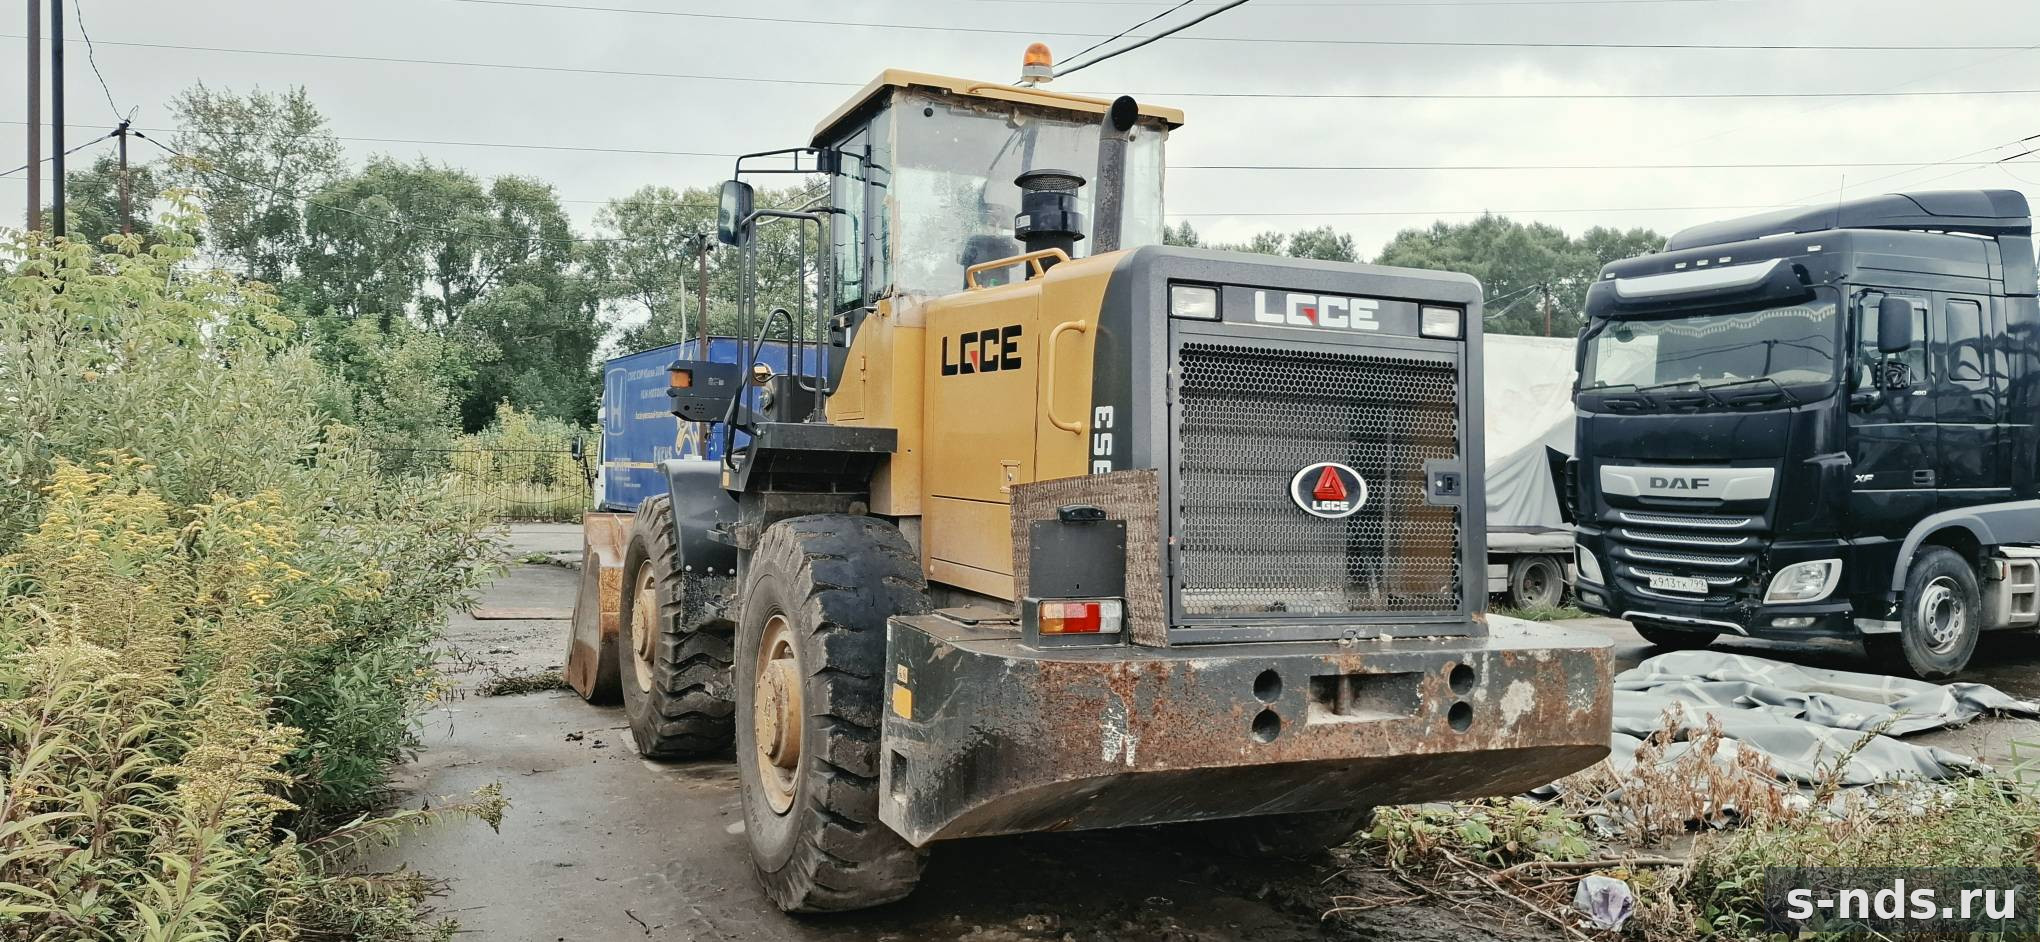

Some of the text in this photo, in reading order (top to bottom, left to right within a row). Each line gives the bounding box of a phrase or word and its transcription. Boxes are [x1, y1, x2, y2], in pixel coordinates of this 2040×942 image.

[1254, 291, 1379, 330] LGCE
[941, 324, 1022, 376] LGCE
[1650, 477, 1709, 489] DAF
[1854, 474, 1874, 483] XF
[1312, 500, 1349, 511] LGCE
